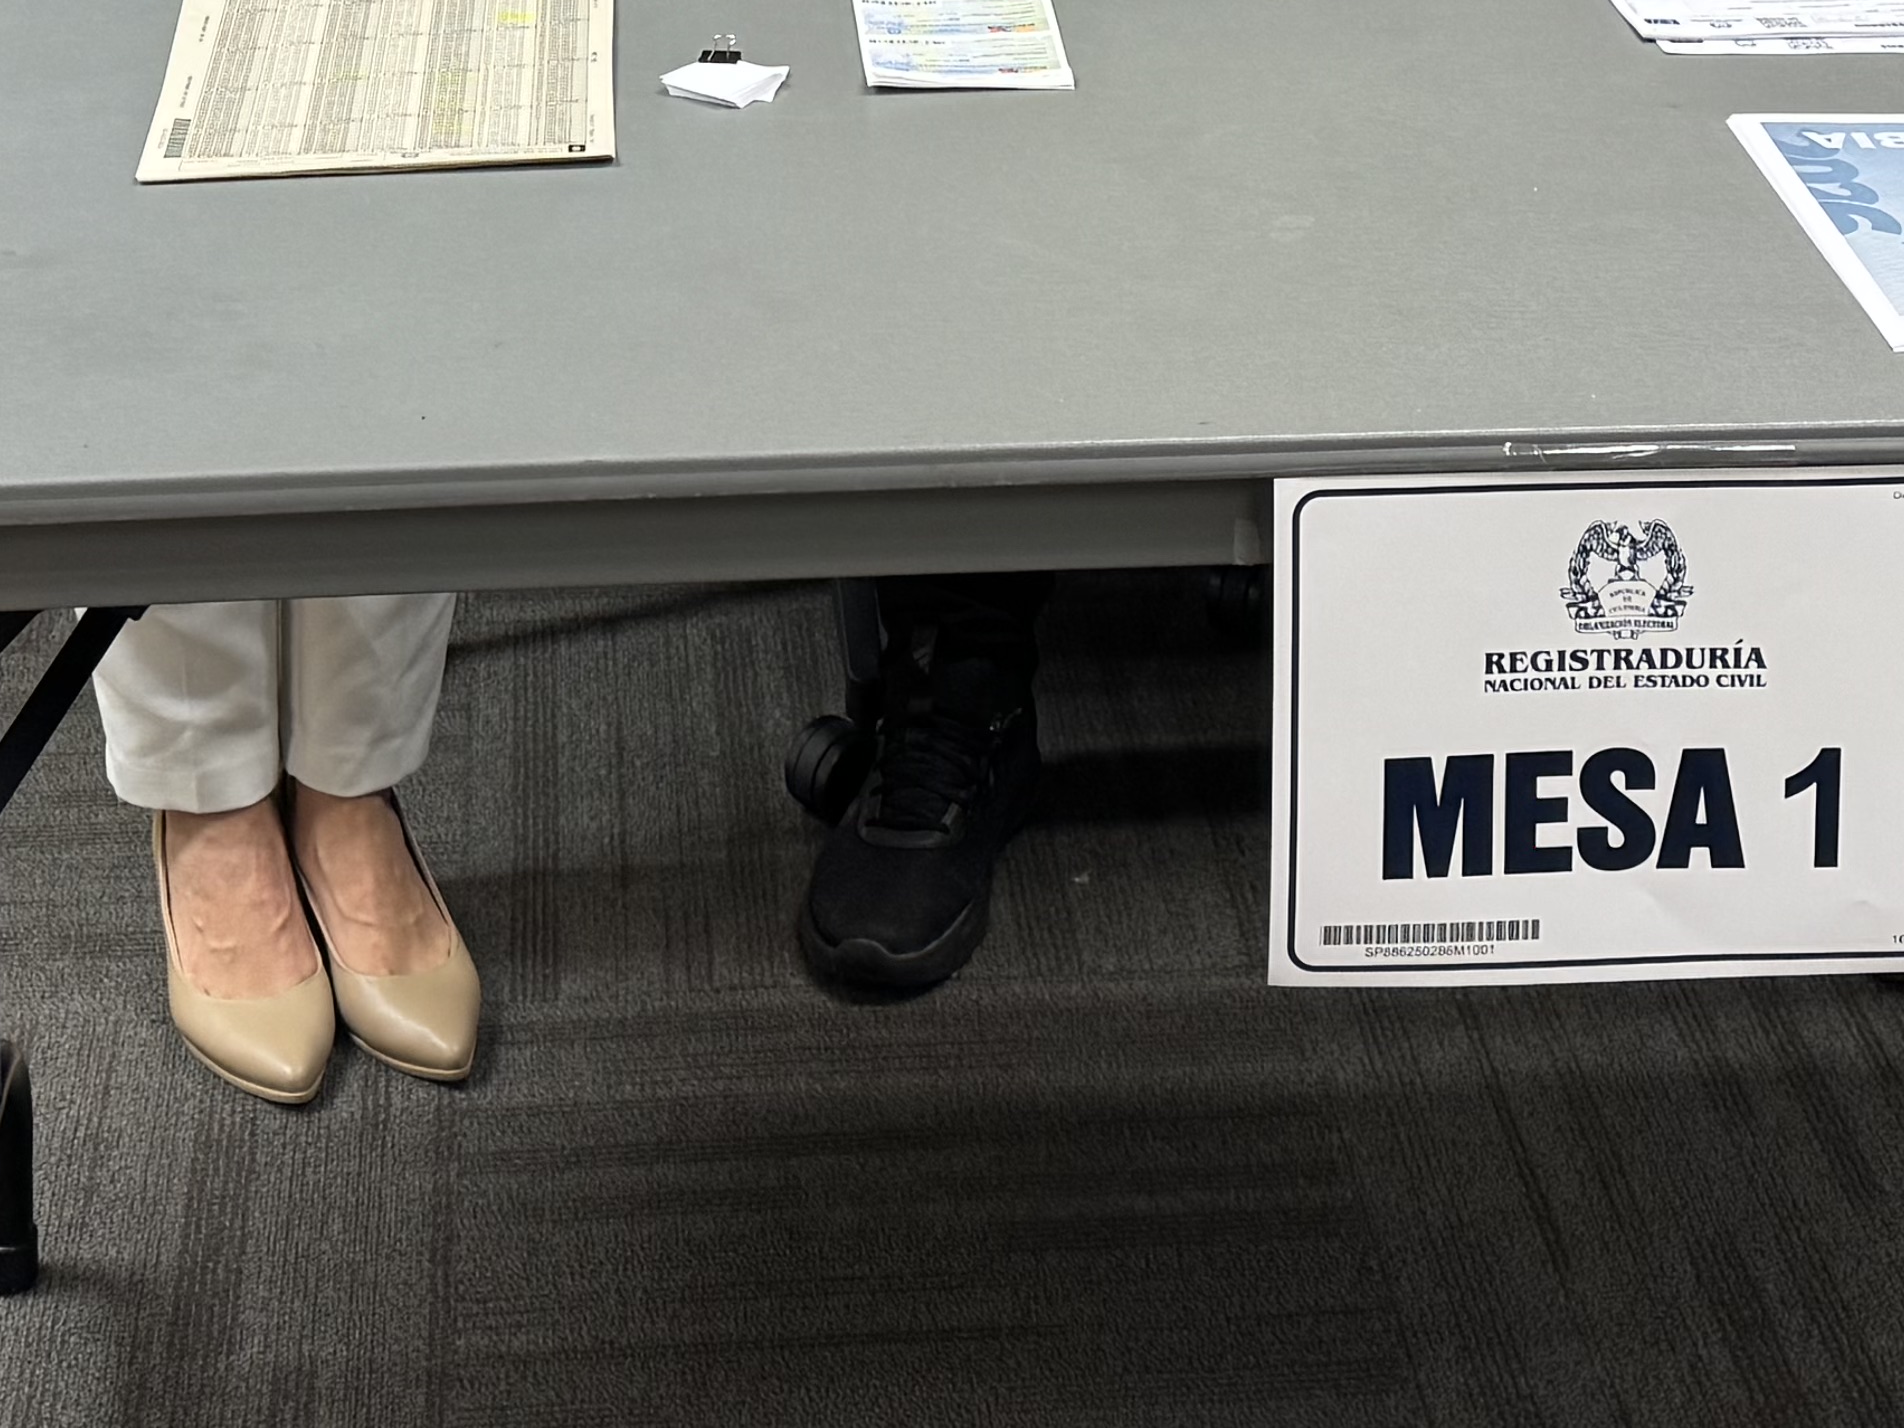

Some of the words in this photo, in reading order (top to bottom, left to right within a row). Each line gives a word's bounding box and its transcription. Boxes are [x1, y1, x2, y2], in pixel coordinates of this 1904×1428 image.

[1484, 638, 1768, 675] REGISTRADURÍA
[1484, 676, 1582, 693] NACIONAL
[1588, 675, 1627, 690] DEL
[1633, 674, 1710, 688] ESTADO
[1716, 674, 1768, 688] CIVIL
[1382, 747, 1746, 881] MESA
[1784, 747, 1842, 868] 1
